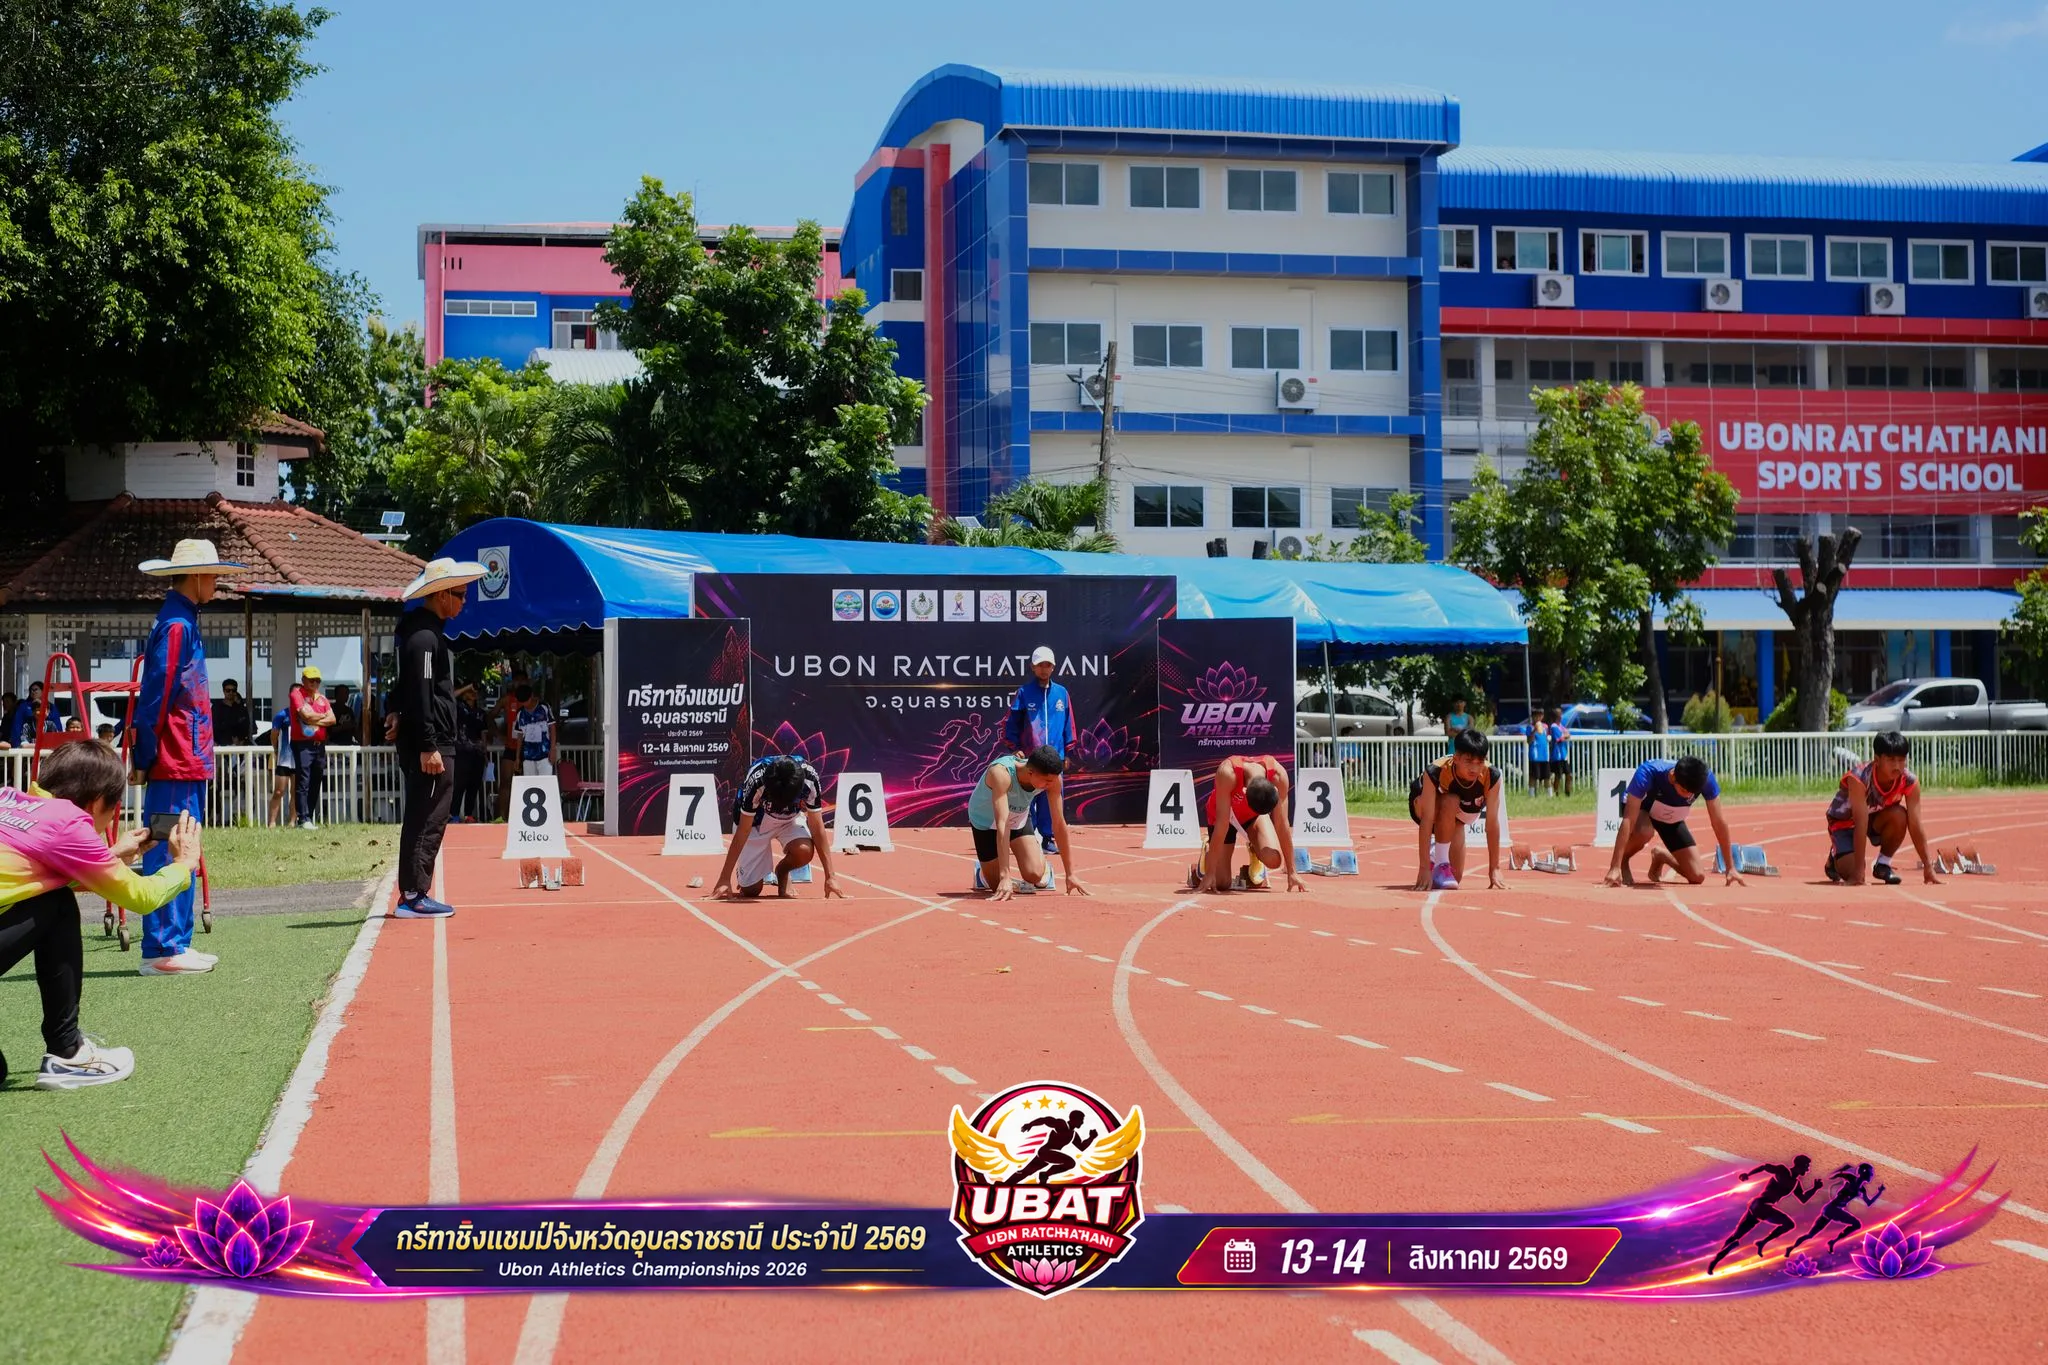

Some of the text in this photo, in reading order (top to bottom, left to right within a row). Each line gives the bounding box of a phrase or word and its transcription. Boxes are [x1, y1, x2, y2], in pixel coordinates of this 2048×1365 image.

[1719, 422, 2047, 454] UBONRATCHATHANI
[1758, 461, 2023, 491] SPORTS SCHOOL
[774, 655, 1110, 677] UBON RATCHATANI
[641, 707, 728, 728] จ.อุบลราชธานี
[1180, 702, 1278, 724] UBON
[1183, 724, 1272, 738] ATHLETICS
[673, 742, 705, 753] สิงหาคม
[707, 742, 729, 753] 2569
[521, 787, 548, 827] 8
[680, 786, 705, 826] 7
[848, 783, 873, 822] 6
[1160, 782, 1184, 821] 4
[1307, 781, 1332, 819] 3
[1611, 780, 1626, 818] 1
[518, 830, 549, 842] Nelco
[676, 829, 706, 840] Nelco
[845, 825, 874, 837] Nelco
[1156, 823, 1186, 835] Nelco
[1303, 821, 1333, 833] Nelco
